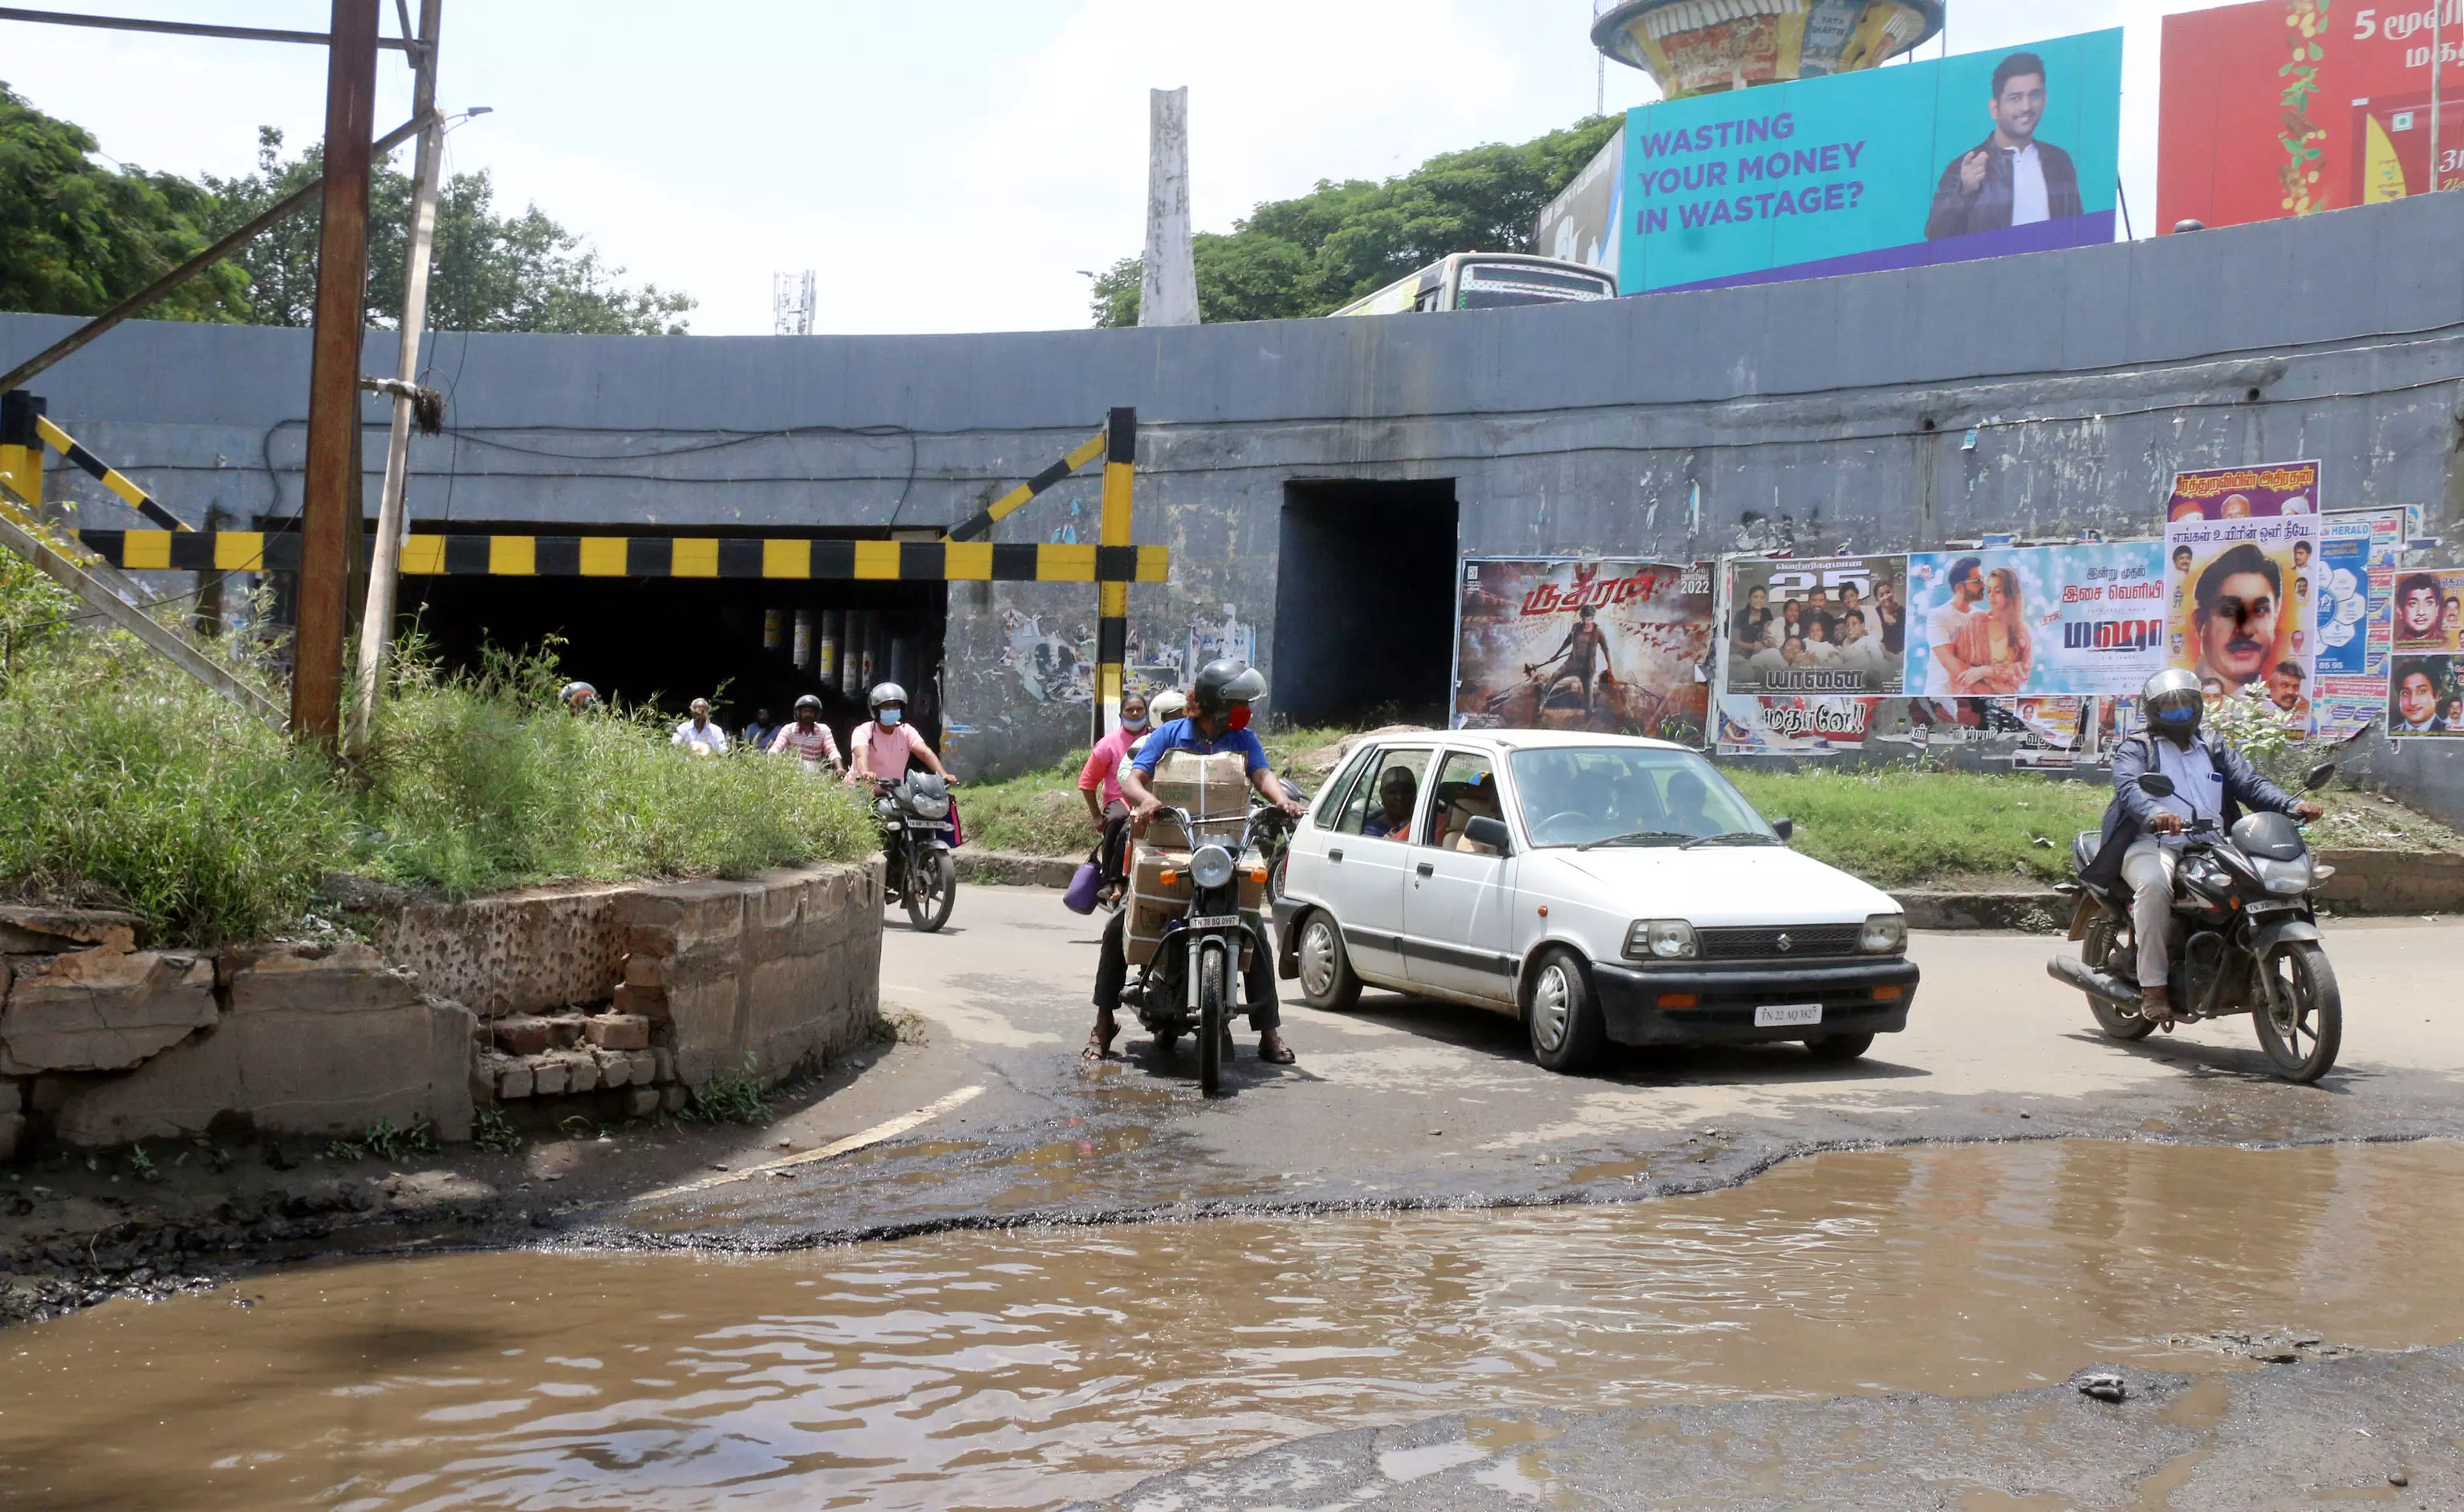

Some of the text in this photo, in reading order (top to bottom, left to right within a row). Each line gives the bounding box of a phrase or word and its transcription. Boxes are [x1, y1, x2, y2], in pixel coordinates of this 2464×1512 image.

[2352, 9, 2376, 40] 5
[1641, 112, 1795, 158] WASTING
[1638, 161, 1727, 197] YOUR
[1737, 140, 1865, 184] MONEY
[1637, 180, 1865, 235] IN WASTAGE?
[2173, 524, 2211, 542] எங்கள்
[2213, 522, 2257, 541] உயிரின்
[2260, 524, 2282, 542] ஒளி
[2332, 525, 2369, 535] HERALD
[1776, 560, 1863, 571] வெற்றிகரமான
[2088, 565, 2145, 582] இன்று முதல்
[1680, 580, 1710, 594] 2022
[1768, 569, 1870, 603] 25
[2061, 585, 2101, 604] இசை
[1194, 918, 1202, 926] TN
[1761, 1011, 1773, 1020] TN
[1775, 1011, 1784, 1020] 22
[1785, 1010, 1798, 1020] AQ
